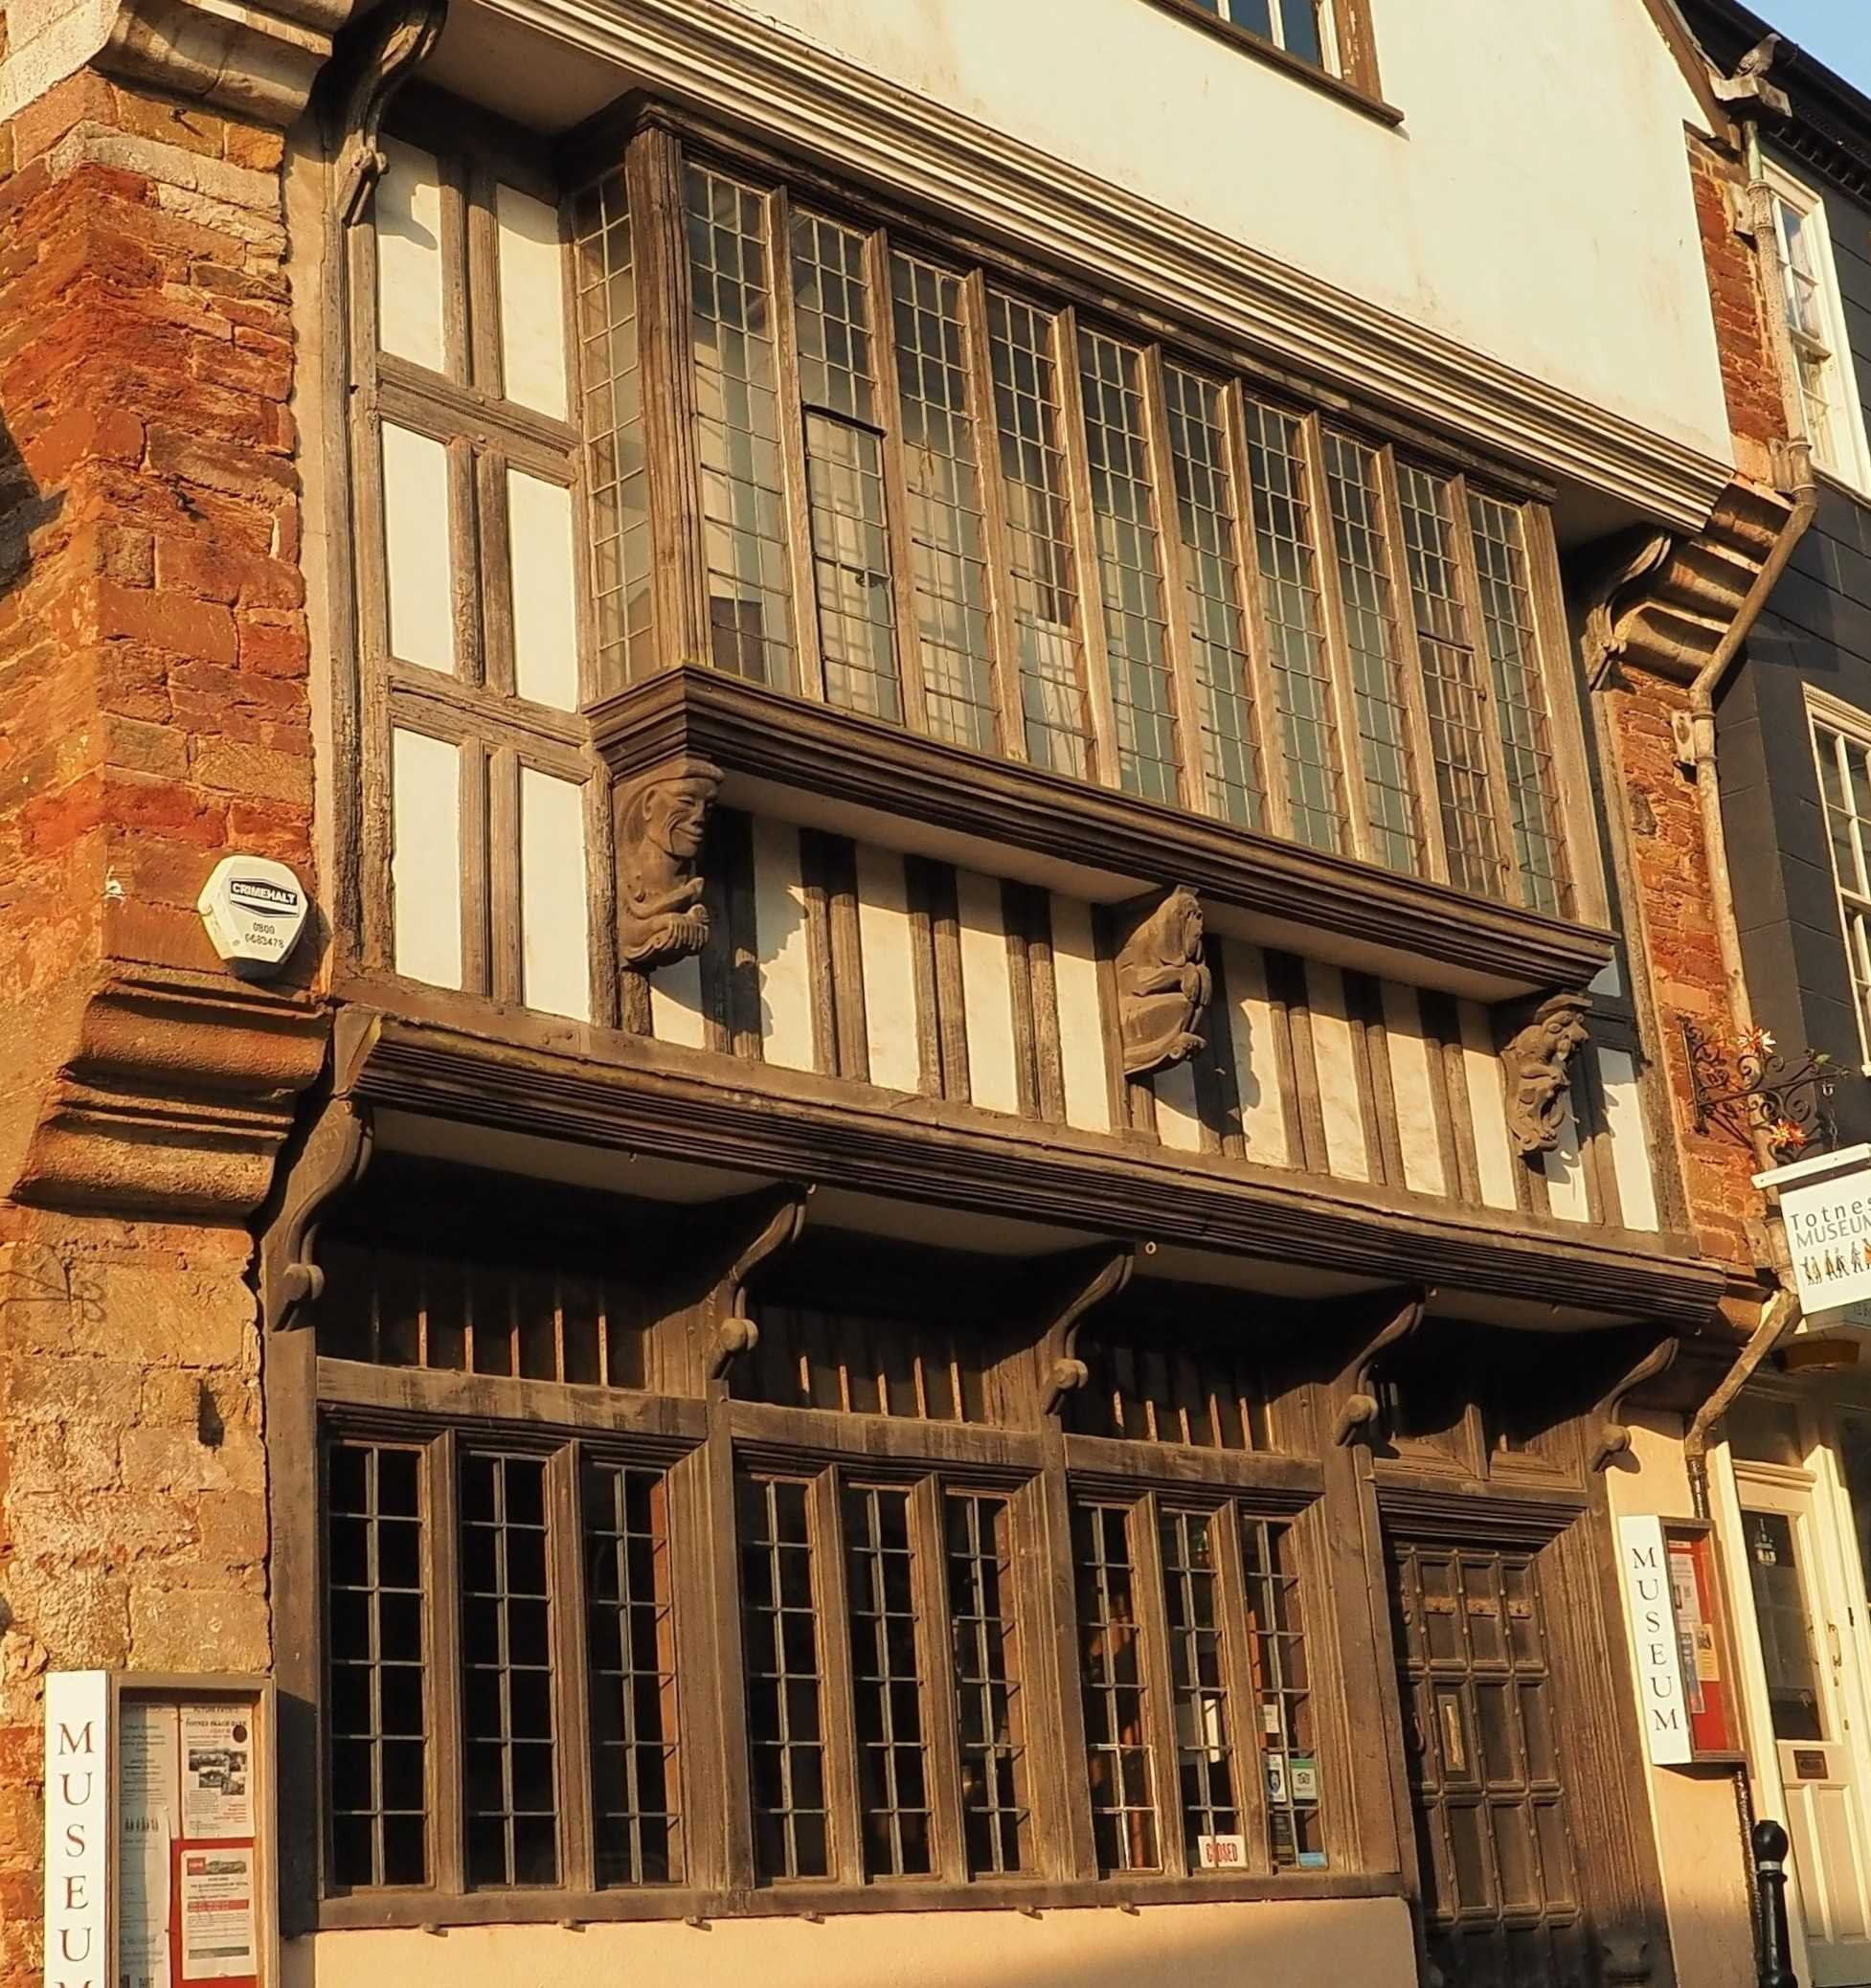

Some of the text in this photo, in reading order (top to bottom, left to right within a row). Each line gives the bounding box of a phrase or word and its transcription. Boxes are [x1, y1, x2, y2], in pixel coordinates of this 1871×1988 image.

[232, 882, 296, 904] CRIMEHALT
[1632, 1547, 1679, 1731] MUSEUM
[55, 1721, 95, 1988] MUSEU
[1206, 1842, 1238, 1863] COSED
